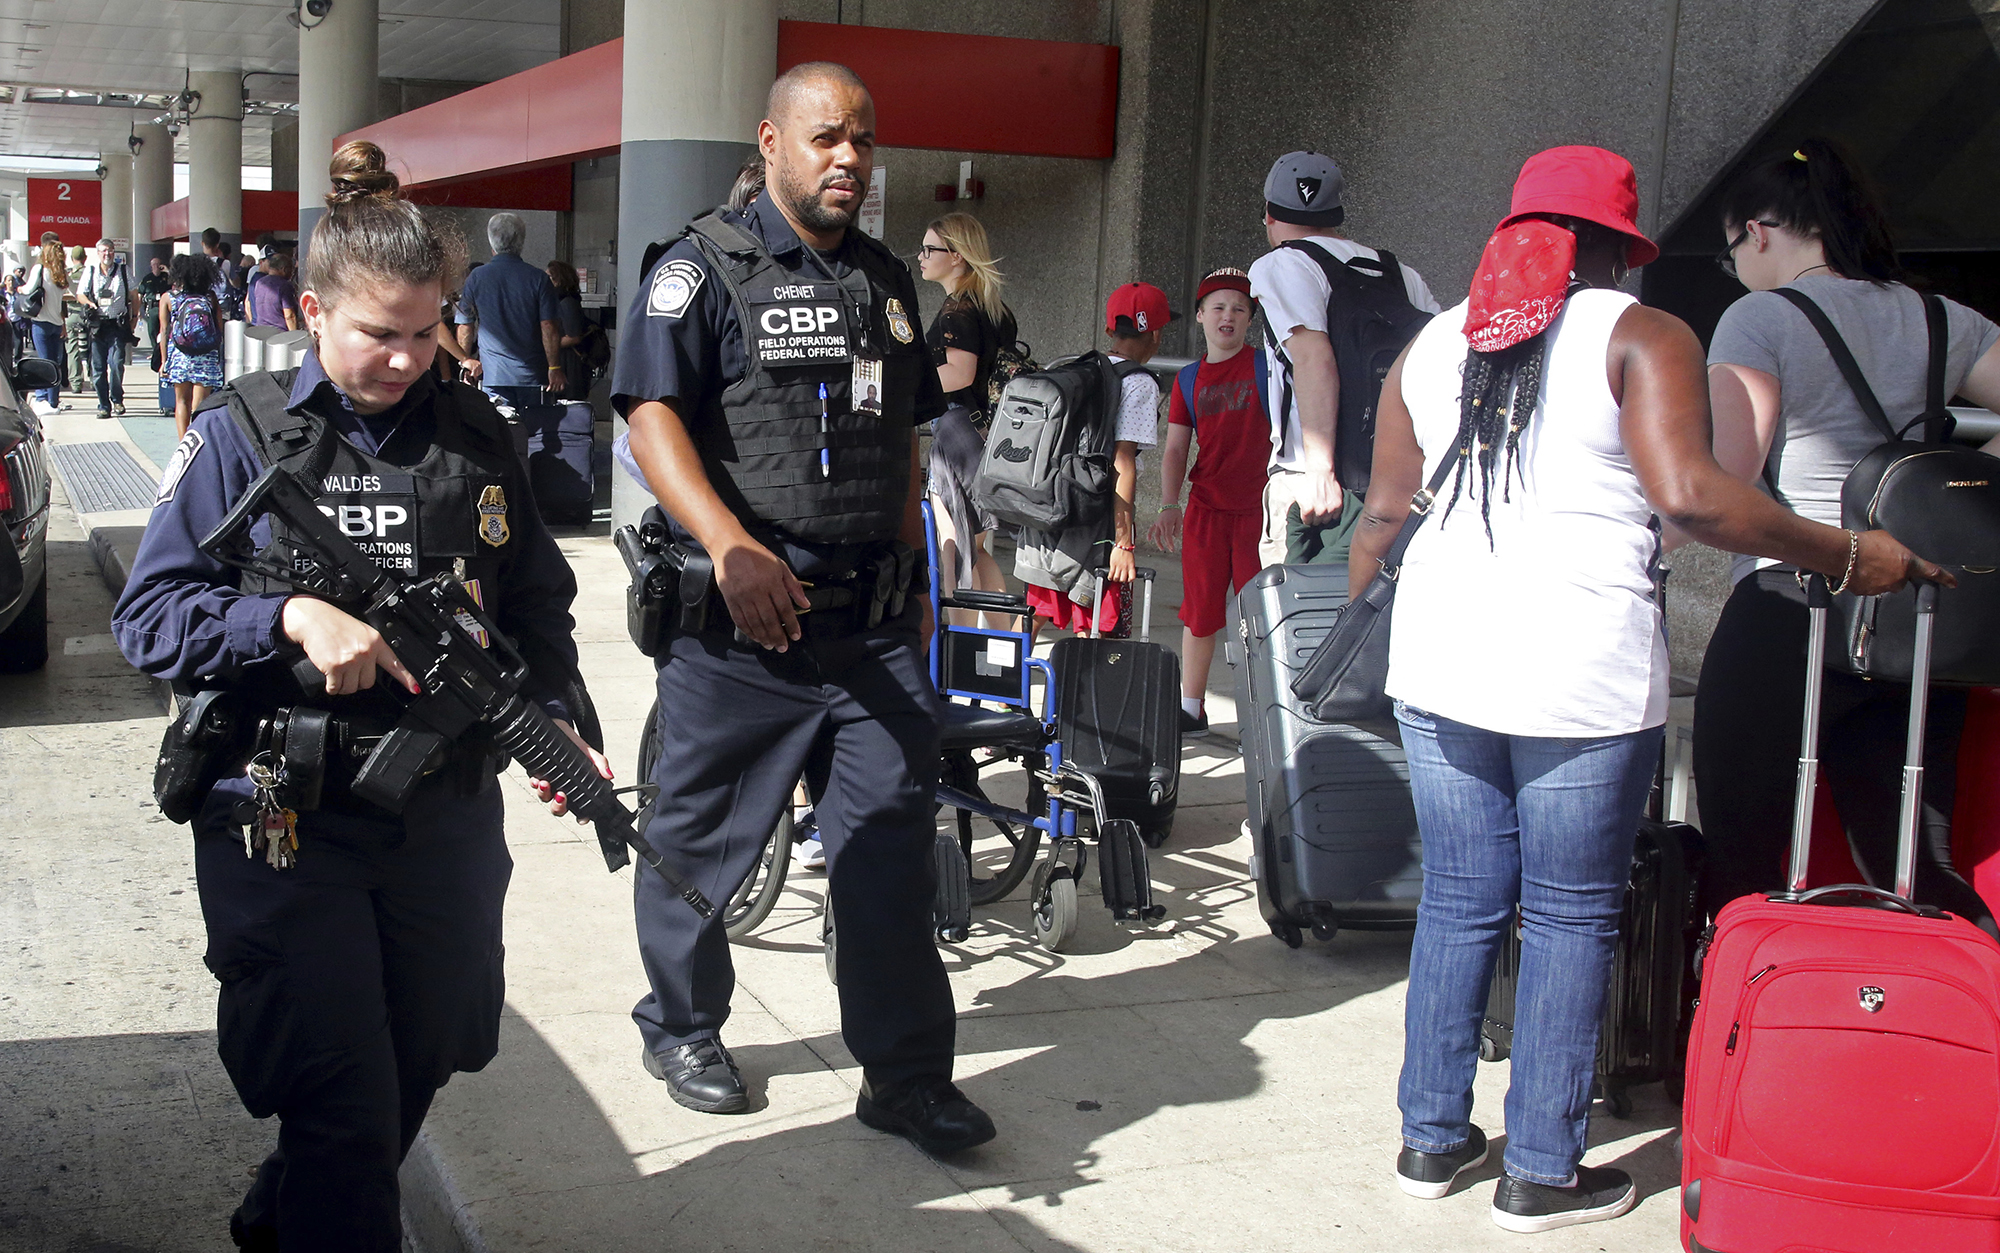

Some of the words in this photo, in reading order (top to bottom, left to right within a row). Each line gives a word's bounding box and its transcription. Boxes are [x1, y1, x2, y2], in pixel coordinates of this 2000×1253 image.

[57, 183, 71, 200] 2
[40, 215, 54, 223] AIR
[57, 215, 90, 224] CANADA
[773, 285, 815, 300] CHENET
[760, 306, 839, 335] CBP
[758, 337, 787, 349] FIELD
[788, 335, 846, 347] OPERATIONS
[760, 348, 806, 361] FEDERAL
[807, 346, 848, 358] OFFICER
[1197, 378, 1256, 418] NIKE
[323, 475, 382, 492] VALDES
[316, 505, 408, 537] BP
[354, 542, 412, 555] RATIONS
[369, 556, 413, 569] FICER
